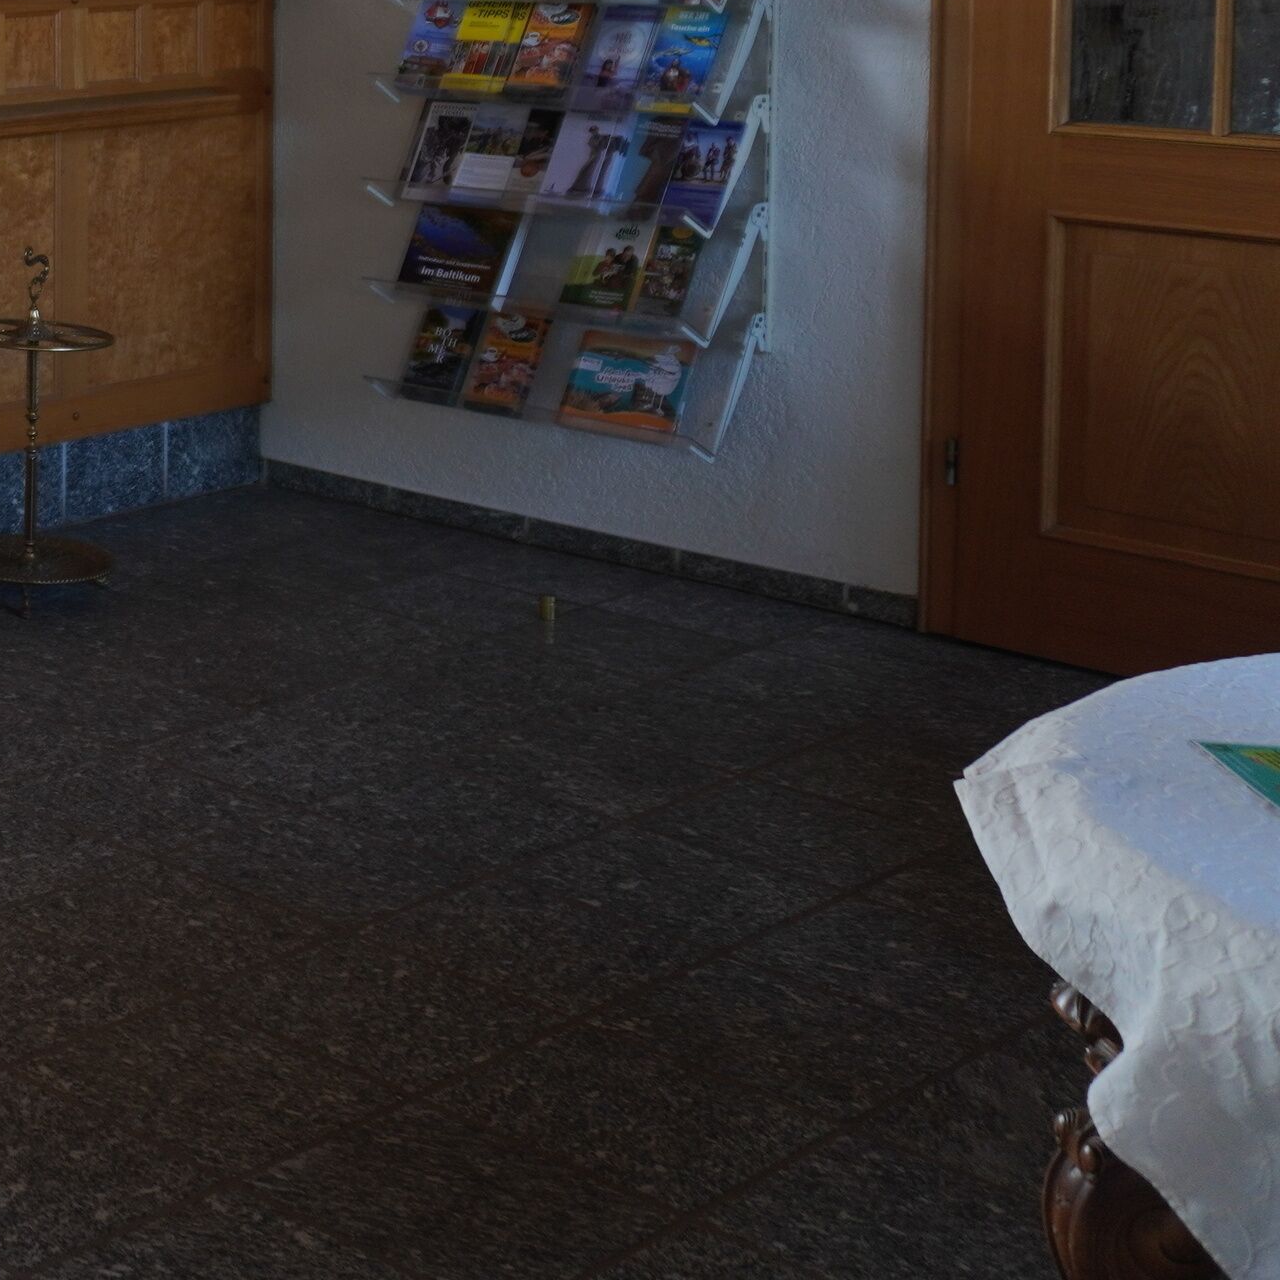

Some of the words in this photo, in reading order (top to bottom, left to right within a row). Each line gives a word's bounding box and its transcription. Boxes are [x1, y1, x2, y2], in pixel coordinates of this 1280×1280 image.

[420, 266, 434, 276] Im
[436, 269, 480, 282] Baltikum
[436, 327, 452, 337] BO
